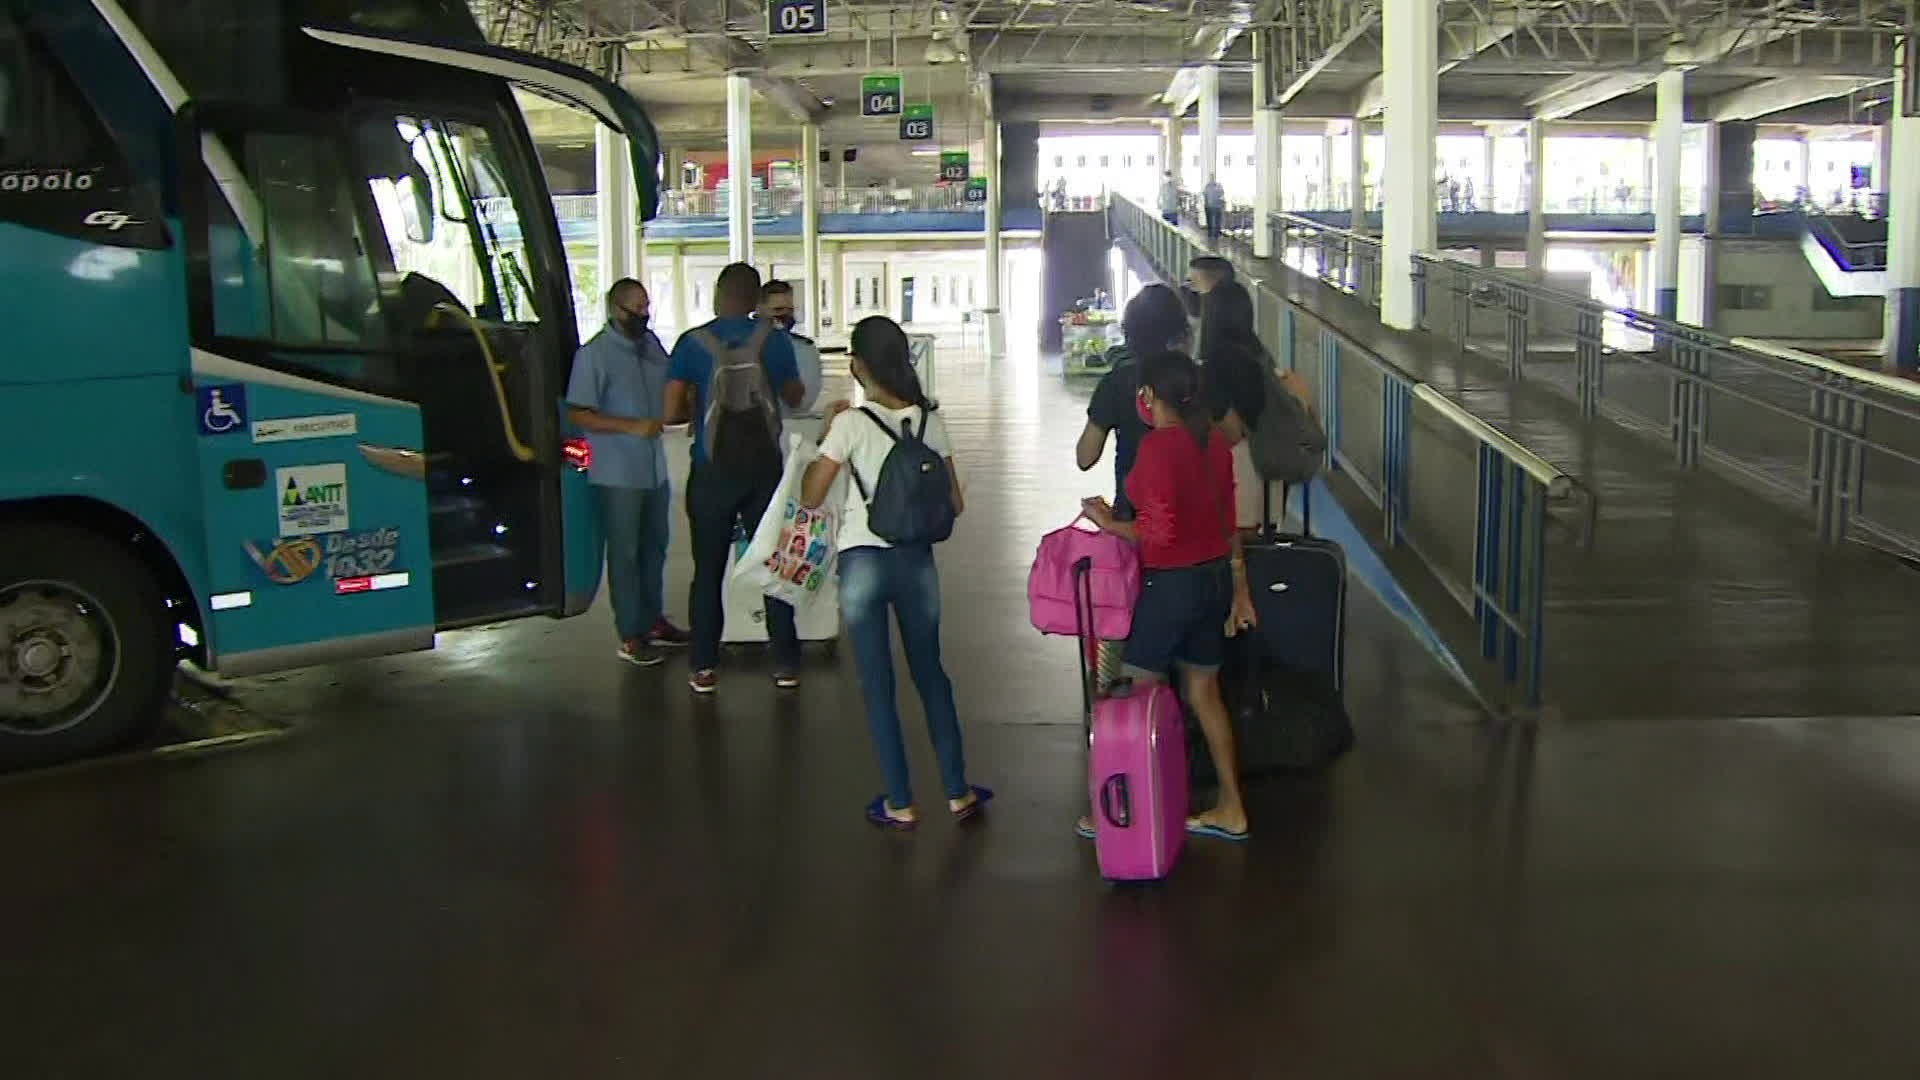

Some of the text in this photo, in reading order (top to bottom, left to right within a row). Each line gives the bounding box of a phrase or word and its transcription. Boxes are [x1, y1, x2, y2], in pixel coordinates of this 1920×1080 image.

[781, 5, 815, 29] 05
[871, 95, 893, 112] 04
[906, 121, 929, 136] 03
[1, 171, 93, 192] opolo
[305, 483, 344, 504] ANTT
[327, 527, 399, 553] Desde
